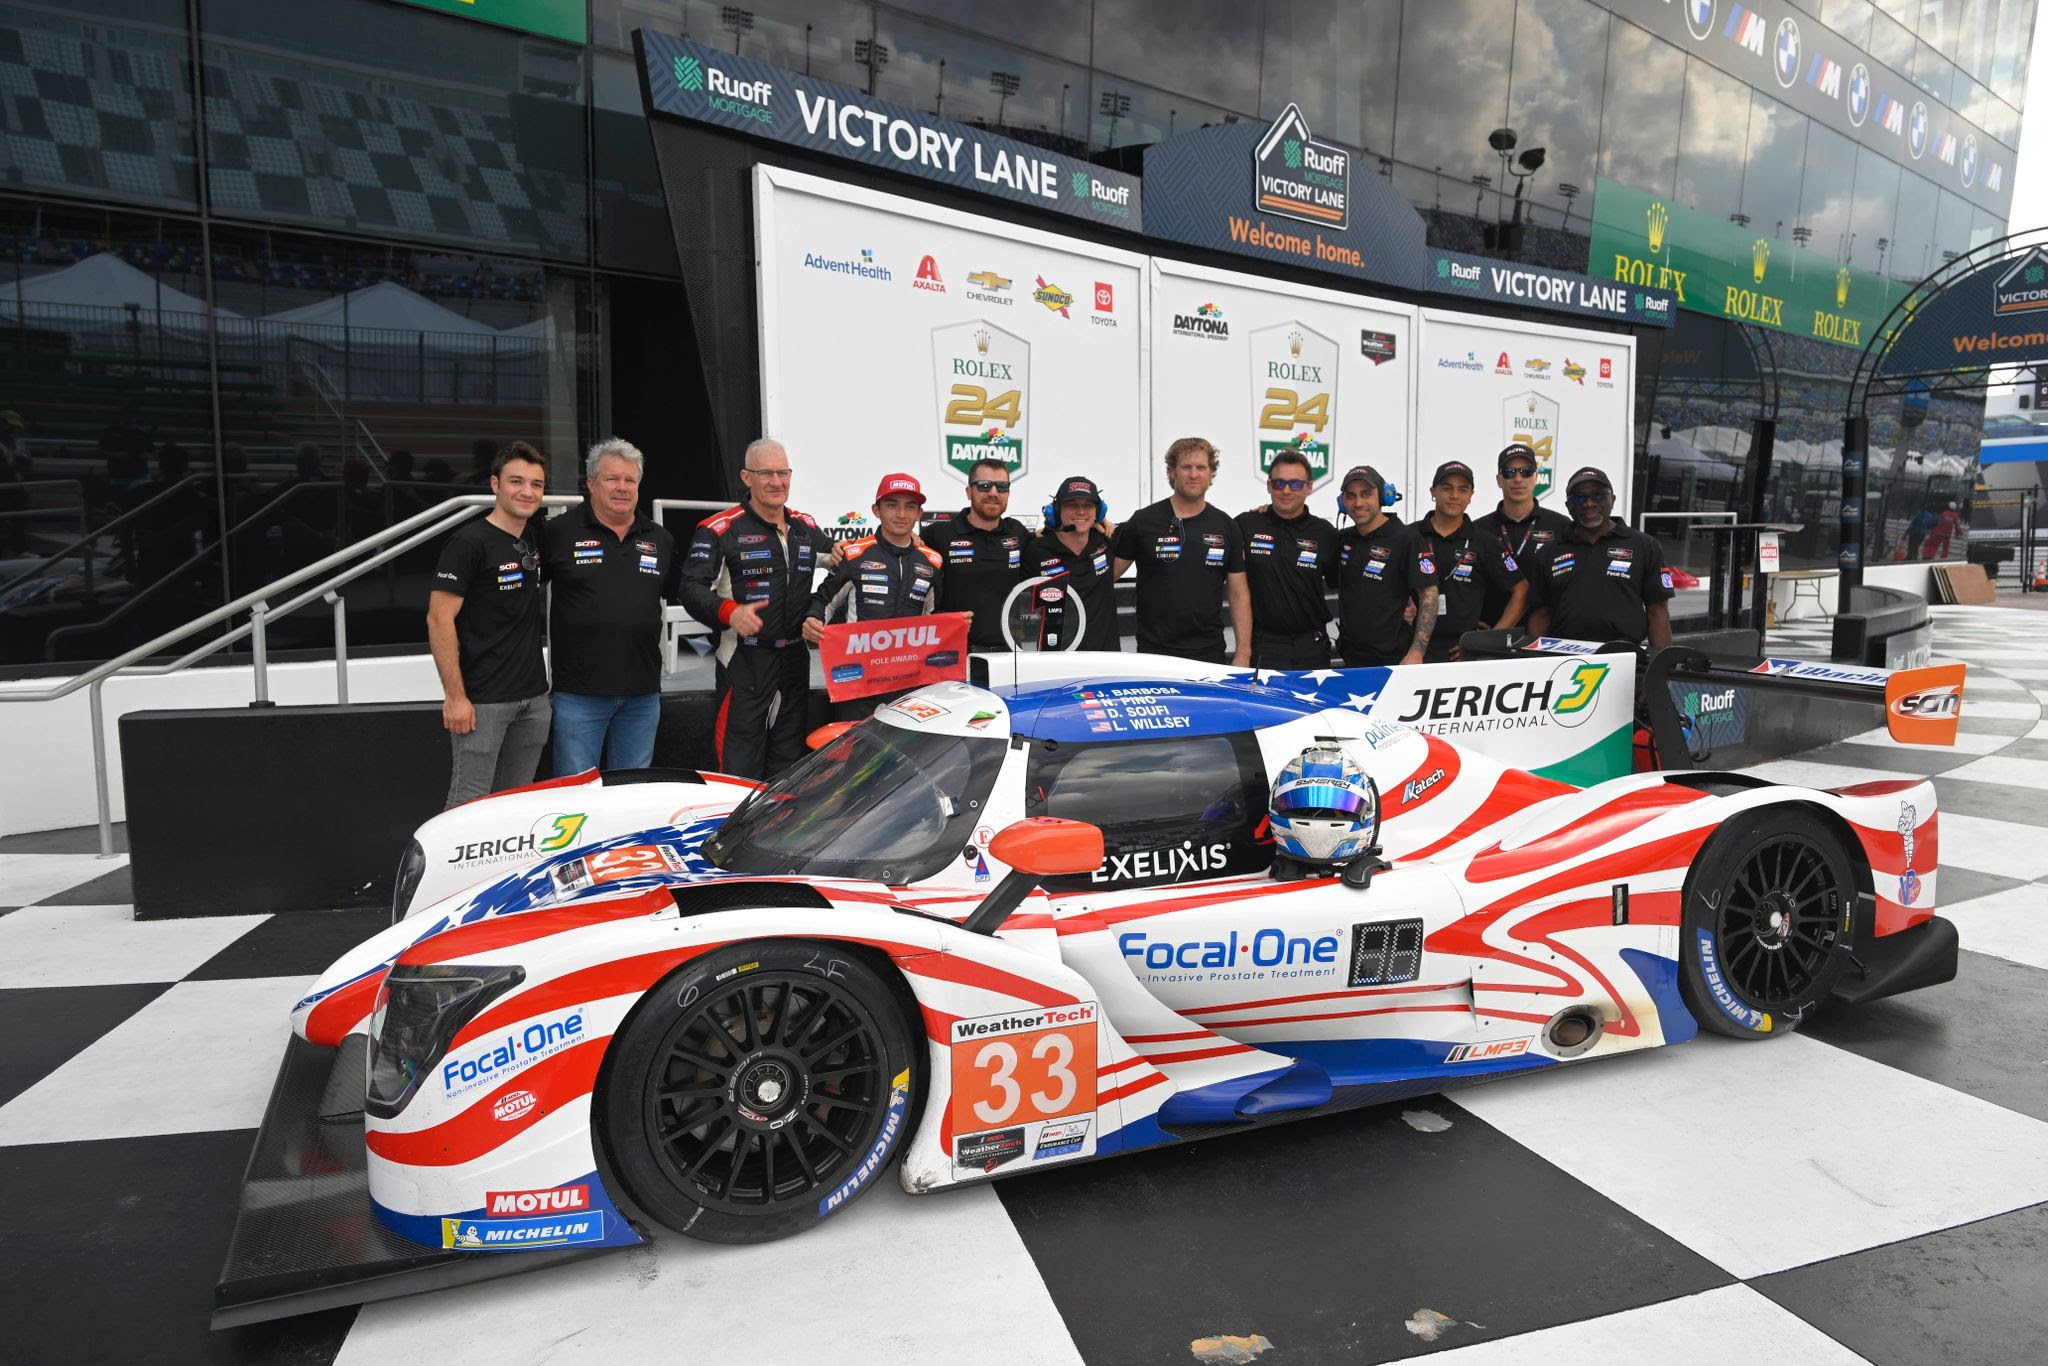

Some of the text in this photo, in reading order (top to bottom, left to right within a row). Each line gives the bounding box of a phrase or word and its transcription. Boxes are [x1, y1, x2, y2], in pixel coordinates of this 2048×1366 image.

[708, 67, 772, 106] Ruoff
[708, 96, 773, 124] MORTGAGE
[795, 89, 1058, 199] VICTORY LANE
[1304, 147, 1345, 175] Ruoff
[1092, 179, 1130, 205] Ruoff
[1261, 175, 1345, 209] VICTORY LANE
[1304, 171, 1344, 190] MORTGAGE
[1229, 216, 1365, 268] Welcome home.
[804, 252, 892, 281] AdventHealth
[1451, 262, 1481, 281] Ruoff
[912, 279, 946, 293] AXALTA
[1490, 267, 1627, 313] VICTORY LANE
[1615, 255, 1687, 302] ROLEX
[966, 291, 1014, 306] CHEVROLET
[1036, 289, 1072, 306] SUNOCO
[1645, 296, 1669, 312] Ruoff
[1724, 286, 1784, 326] ROLEX
[1090, 315, 1117, 328] TOYOTA
[1173, 314, 1229, 335] DAYTONA
[1813, 311, 1861, 345] ROLEX
[952, 357, 1013, 380] ROLEX
[1267, 361, 1322, 384] ROLEX
[944, 383, 1021, 428] 24
[1259, 387, 1329, 432] 24
[1514, 417, 1548, 430] ROLEX
[951, 443, 1019, 463] DAYTONA
[821, 527, 874, 541] AYTONA
[846, 625, 940, 655] MOTUL
[870, 656, 889, 666] POLE
[890, 654, 919, 663] AWARD
[1796, 666, 1888, 683] iRacin
[1101, 696, 1157, 707] N. PINO
[1111, 687, 1180, 697] BARBOSA
[1398, 680, 1553, 723] JERICH
[1701, 689, 1735, 712] Ruoff
[1107, 705, 1170, 719] D. SOUFI
[1112, 716, 1190, 731] L. WILLSEY
[1413, 714, 1549, 736] NTERNATIONAL
[1295, 778, 1351, 790] SYNERGY
[1401, 768, 1446, 805] Katech
[448, 833, 536, 864] JERICH
[979, 831, 990, 845] E
[453, 851, 536, 870] INTERNATIONAL
[1136, 967, 1336, 983] n-Invasive Prostate Treatment
[1701, 938, 1749, 1021] MICHELIN
[958, 1006, 1092, 1037] WeatherTech
[1469, 1040, 1527, 1057] LMP3
[446, 1033, 585, 1099] Non-Invasive Prostate Treatment
[973, 1033, 1077, 1124] 33
[494, 1093, 537, 1119] MOTUL
[961, 1139, 1022, 1156] WeatherTech
[828, 1111, 900, 1210] MICHELIN
[493, 1189, 583, 1213] MOTUL
[486, 1222, 589, 1241] MICHELIN
